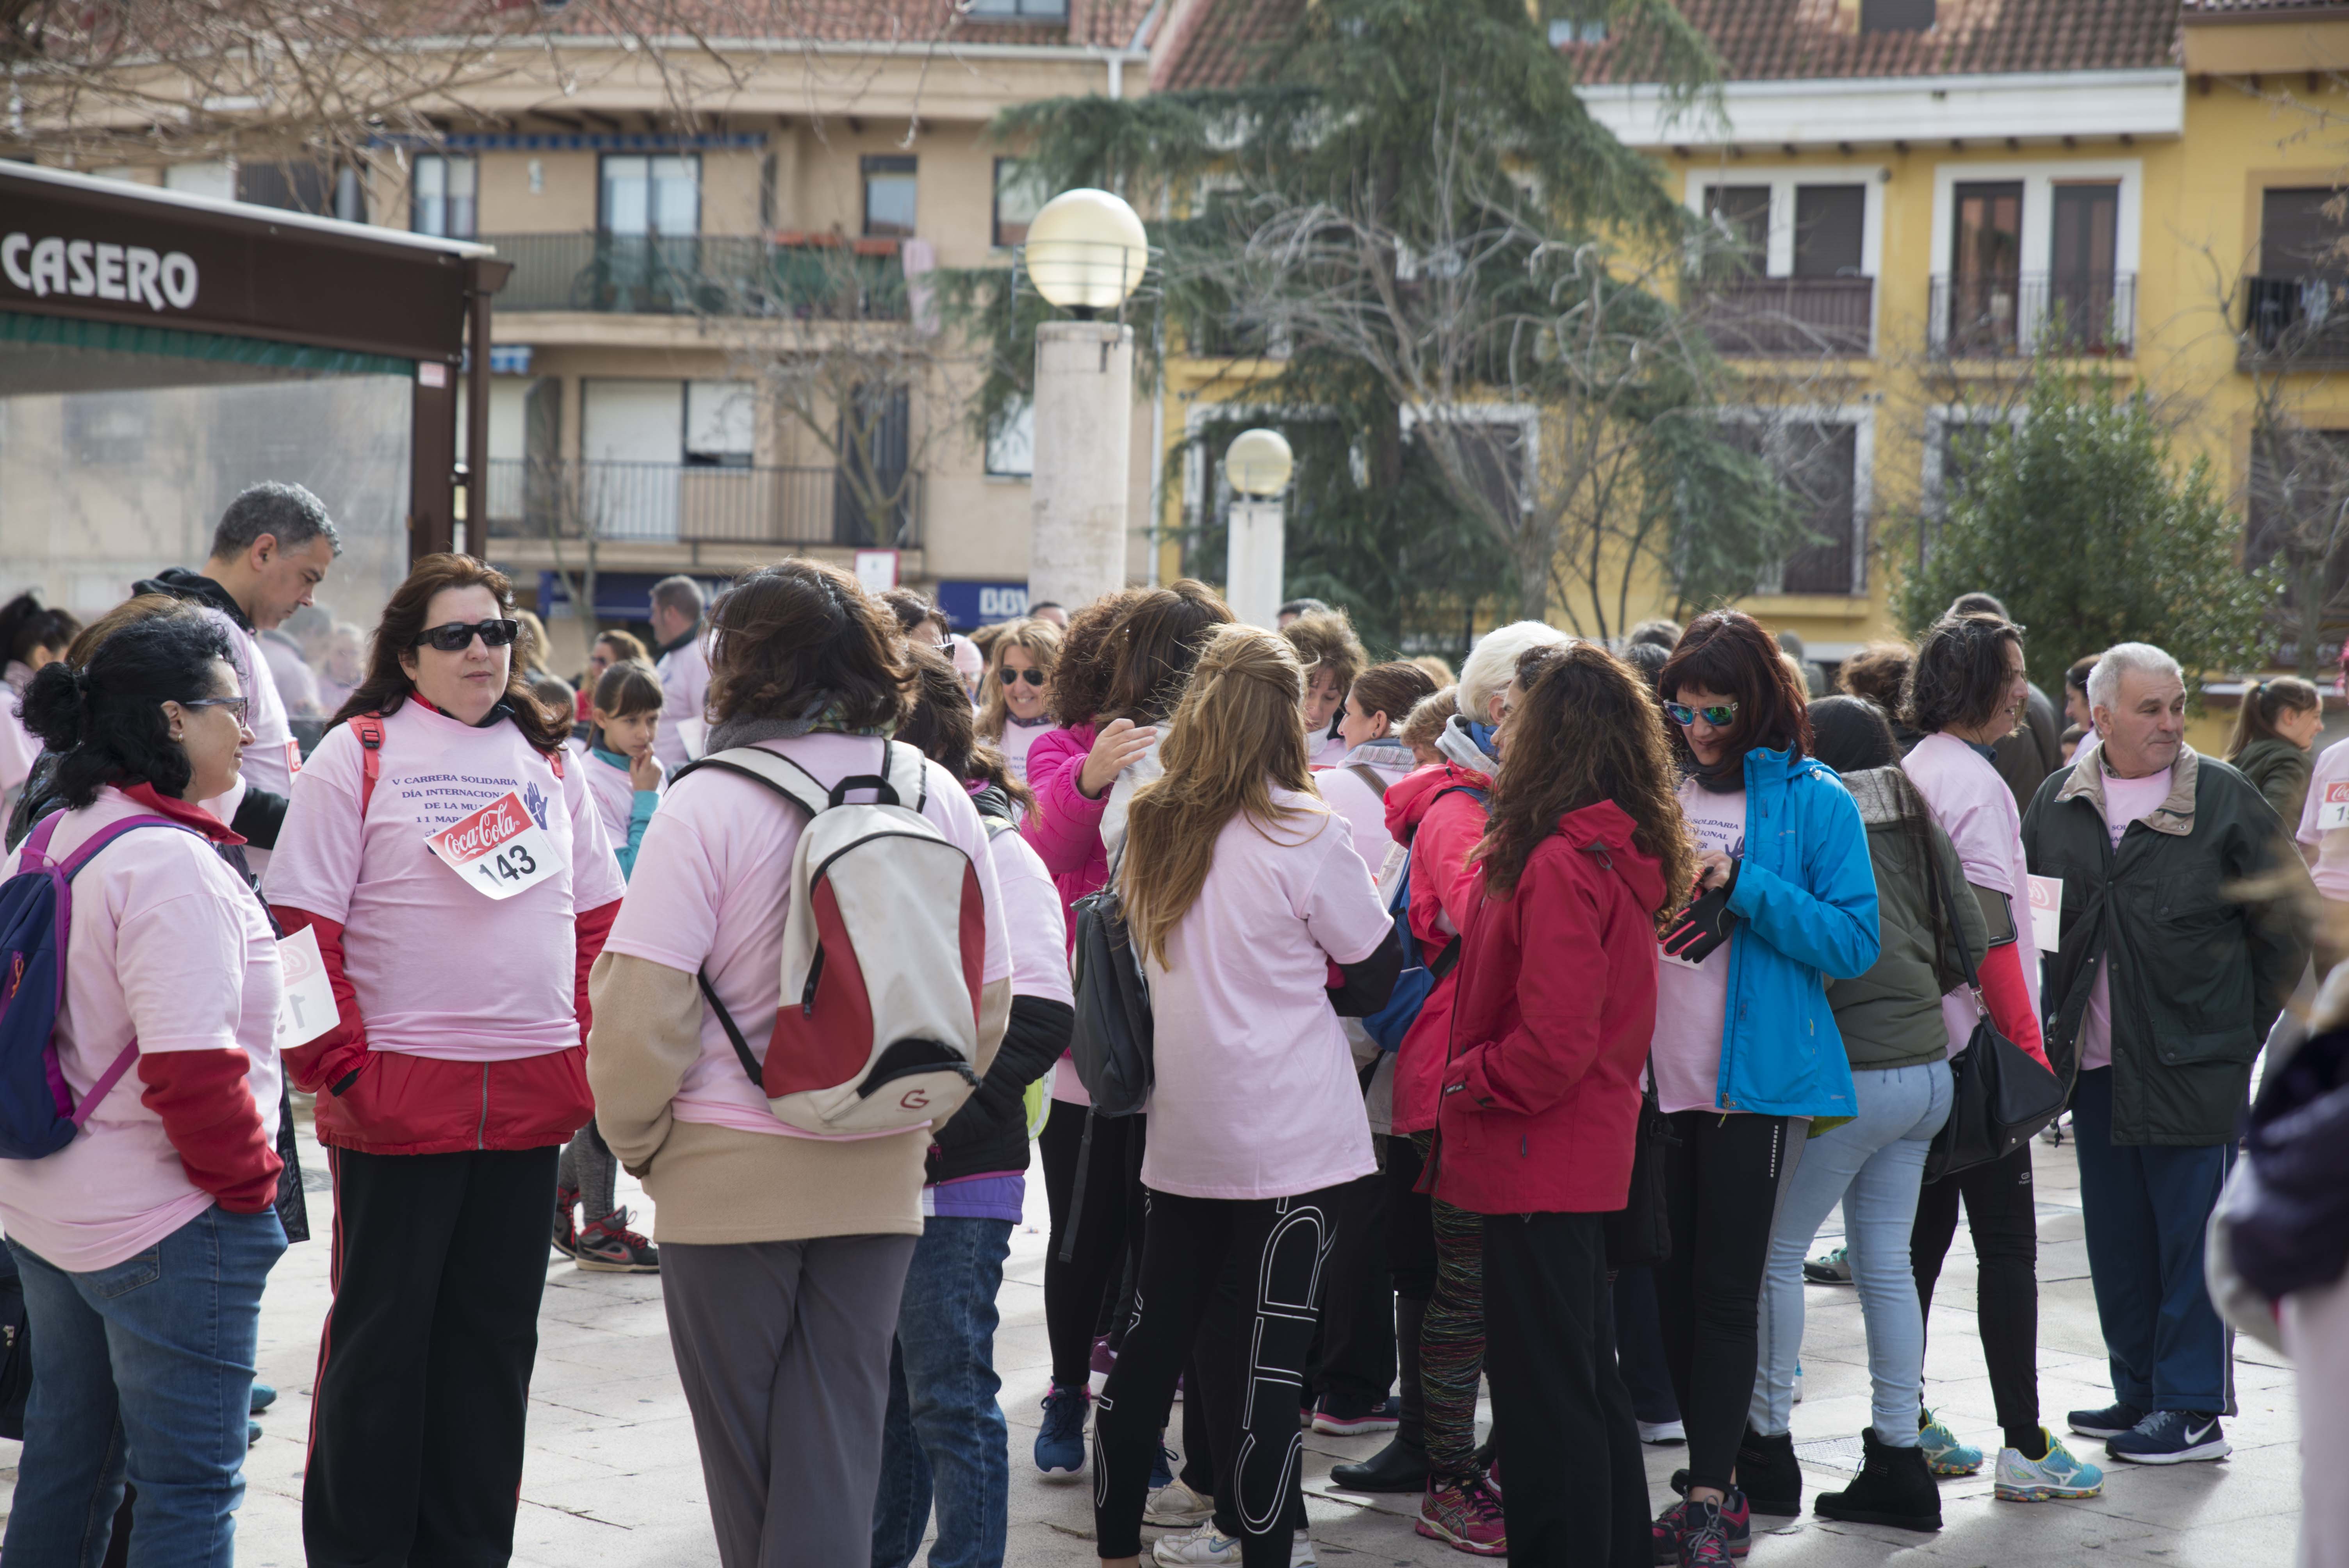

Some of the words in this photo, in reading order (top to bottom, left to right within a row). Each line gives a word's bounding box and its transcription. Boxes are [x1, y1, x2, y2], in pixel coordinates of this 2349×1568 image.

[1, 232, 200, 312] CASERO
[402, 789, 422, 798] DÍA
[426, 788, 504, 798] INTERNACION
[404, 774, 458, 784] CARRERA
[461, 775, 518, 786] SOLIDARIA
[479, 845, 536, 887] 143
